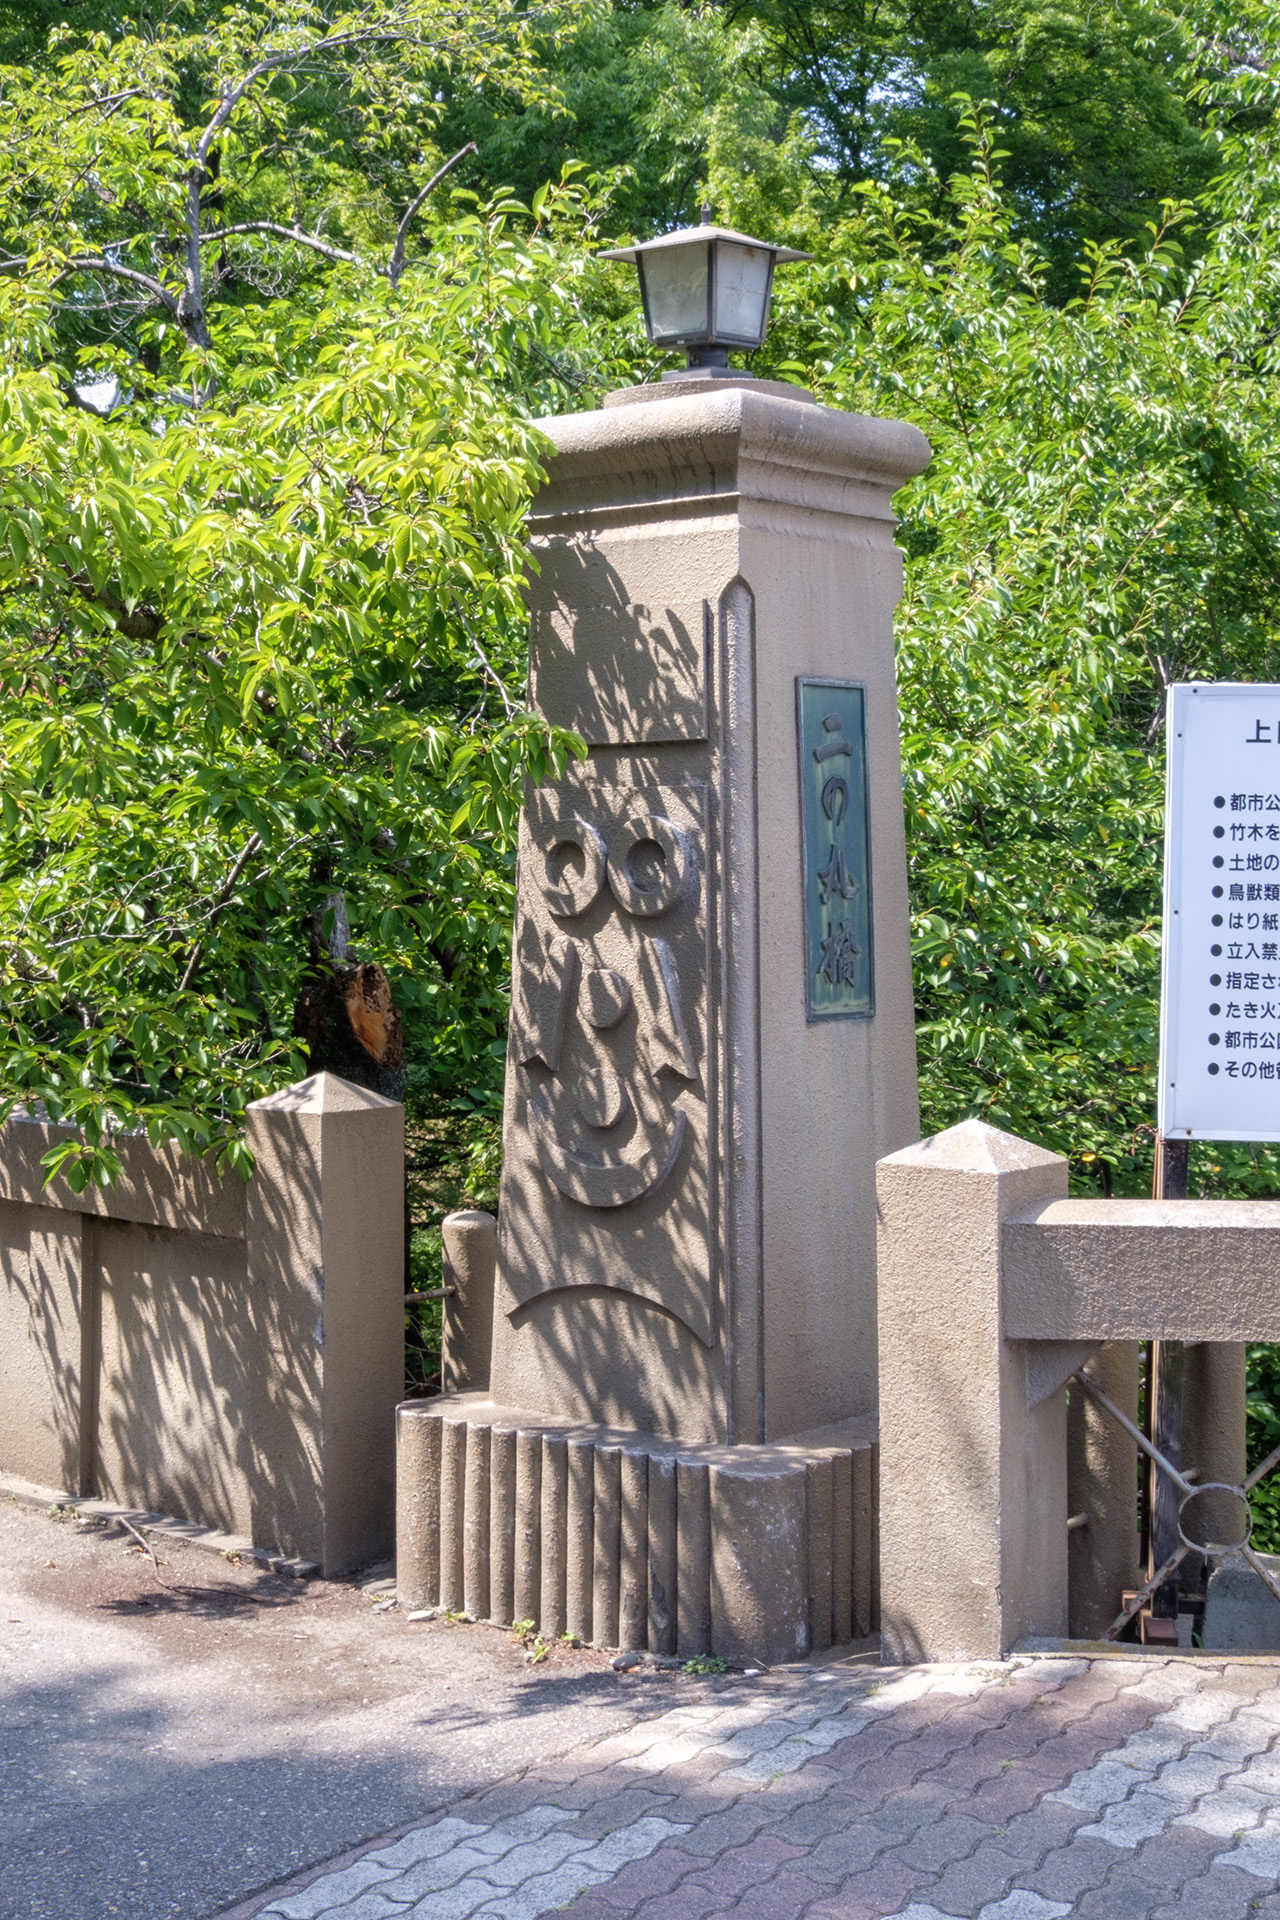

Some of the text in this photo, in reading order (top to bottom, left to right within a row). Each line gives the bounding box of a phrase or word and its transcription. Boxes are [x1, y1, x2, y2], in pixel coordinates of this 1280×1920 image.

[1246, 719, 1280, 744] 上
[1230, 793, 1280, 812] 都市公
[1229, 823, 1280, 841] 竹木を
[1229, 853, 1280, 871] 土地の
[1228, 883, 1280, 901] 鳥獣類
[1229, 912, 1280, 931] はり紙
[1227, 942, 1280, 960] 立入禁
[1226, 971, 1280, 990] 指定さ
[1226, 1001, 1280, 1019] たき火
[1225, 1030, 1280, 1050] 都市公
[1225, 1061, 1280, 1080] その他
